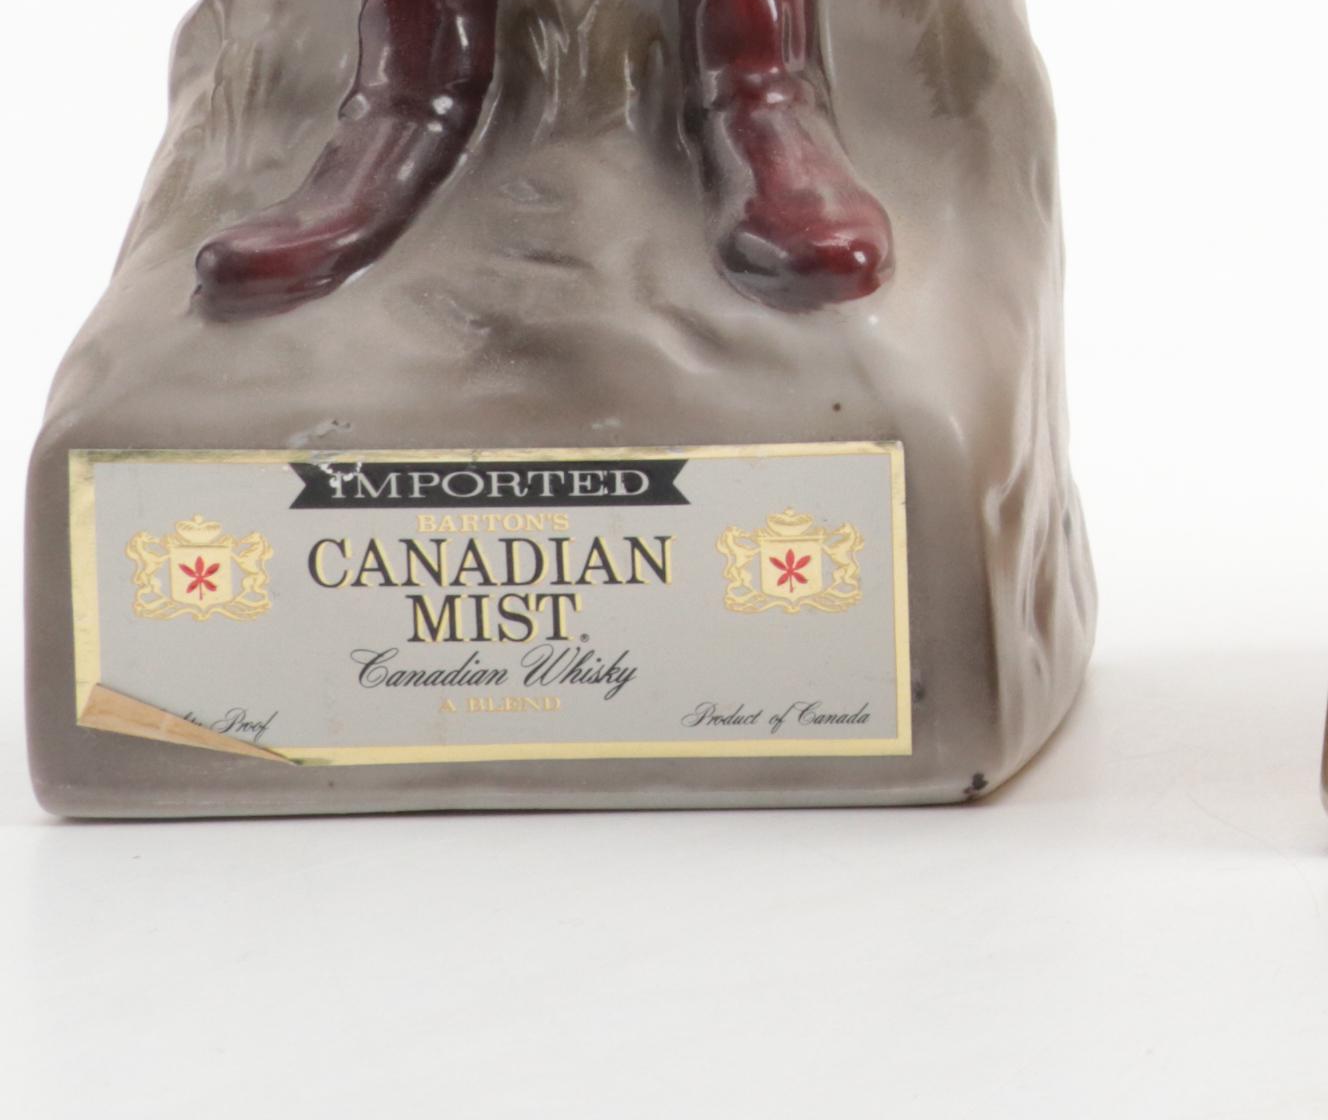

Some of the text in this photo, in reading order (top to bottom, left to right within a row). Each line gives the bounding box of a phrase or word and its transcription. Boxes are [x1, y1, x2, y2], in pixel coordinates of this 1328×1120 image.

[330, 469, 650, 499] IMPORTED
[416, 513, 571, 534] BARTON'S
[308, 535, 675, 589] CANADIAN
[350, 644, 637, 700] Canadian Whisky
[210, 707, 279, 742] Proof
[681, 701, 870, 733] Product of Canada
